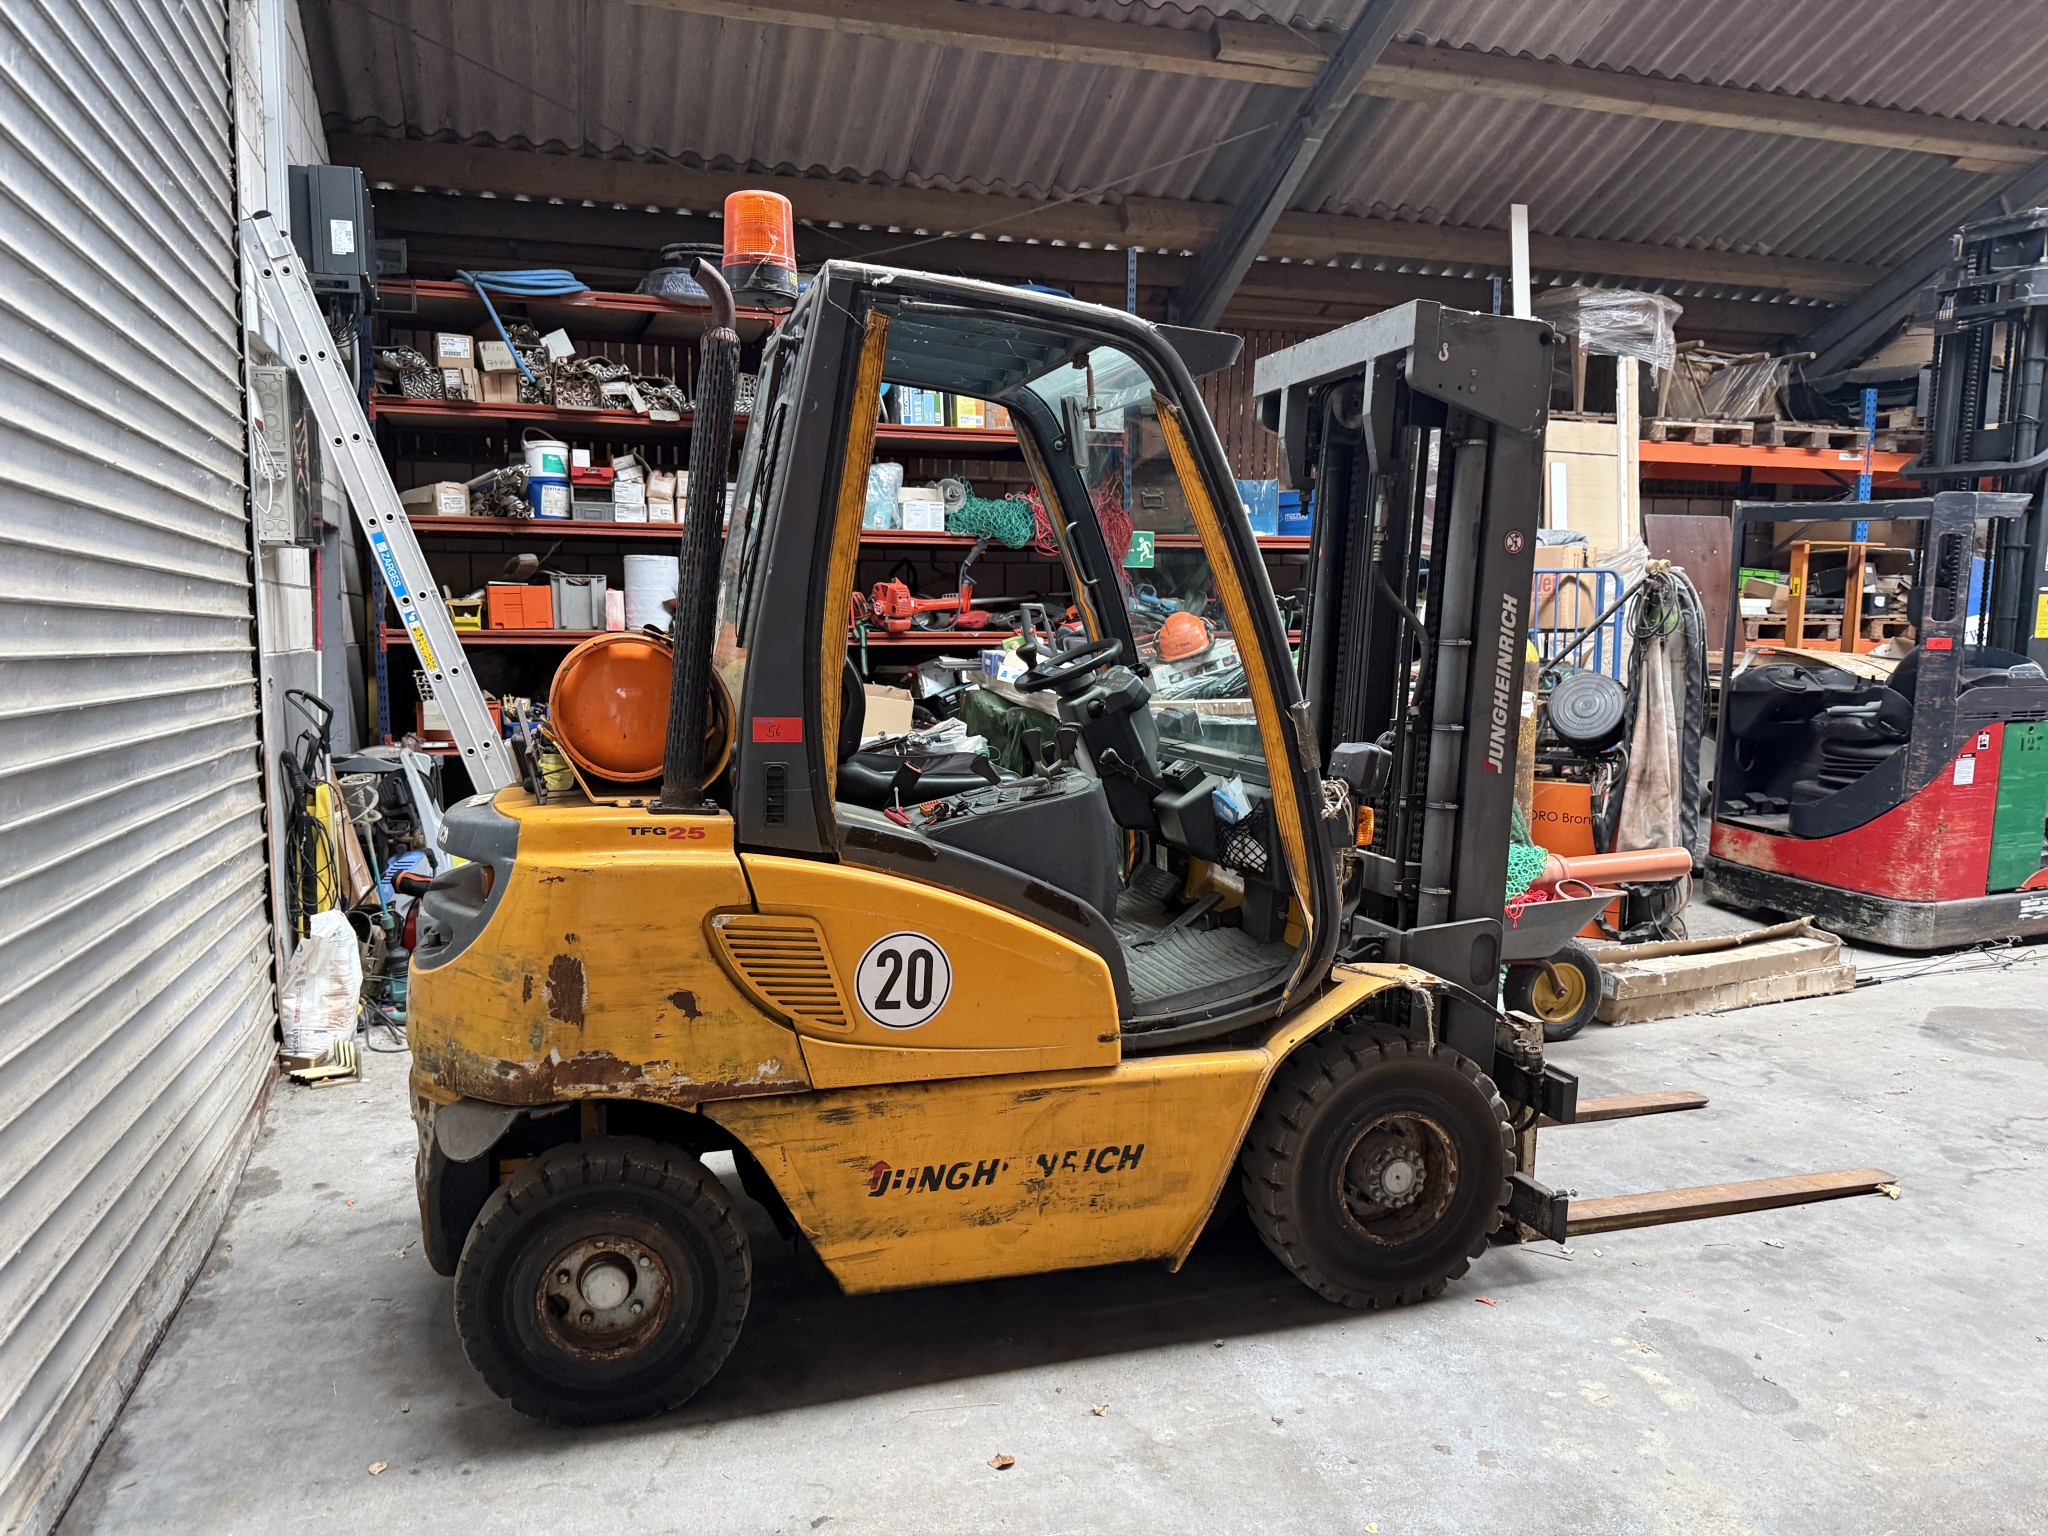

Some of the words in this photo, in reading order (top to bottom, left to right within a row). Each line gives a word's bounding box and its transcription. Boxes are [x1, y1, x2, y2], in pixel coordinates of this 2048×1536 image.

[914, 407, 922, 422] 510
[381, 551, 402, 588] ZARGES
[1488, 593, 1518, 774] JUNGHEINRICH
[766, 724, 782, 738] 56
[874, 948, 934, 1011] 20
